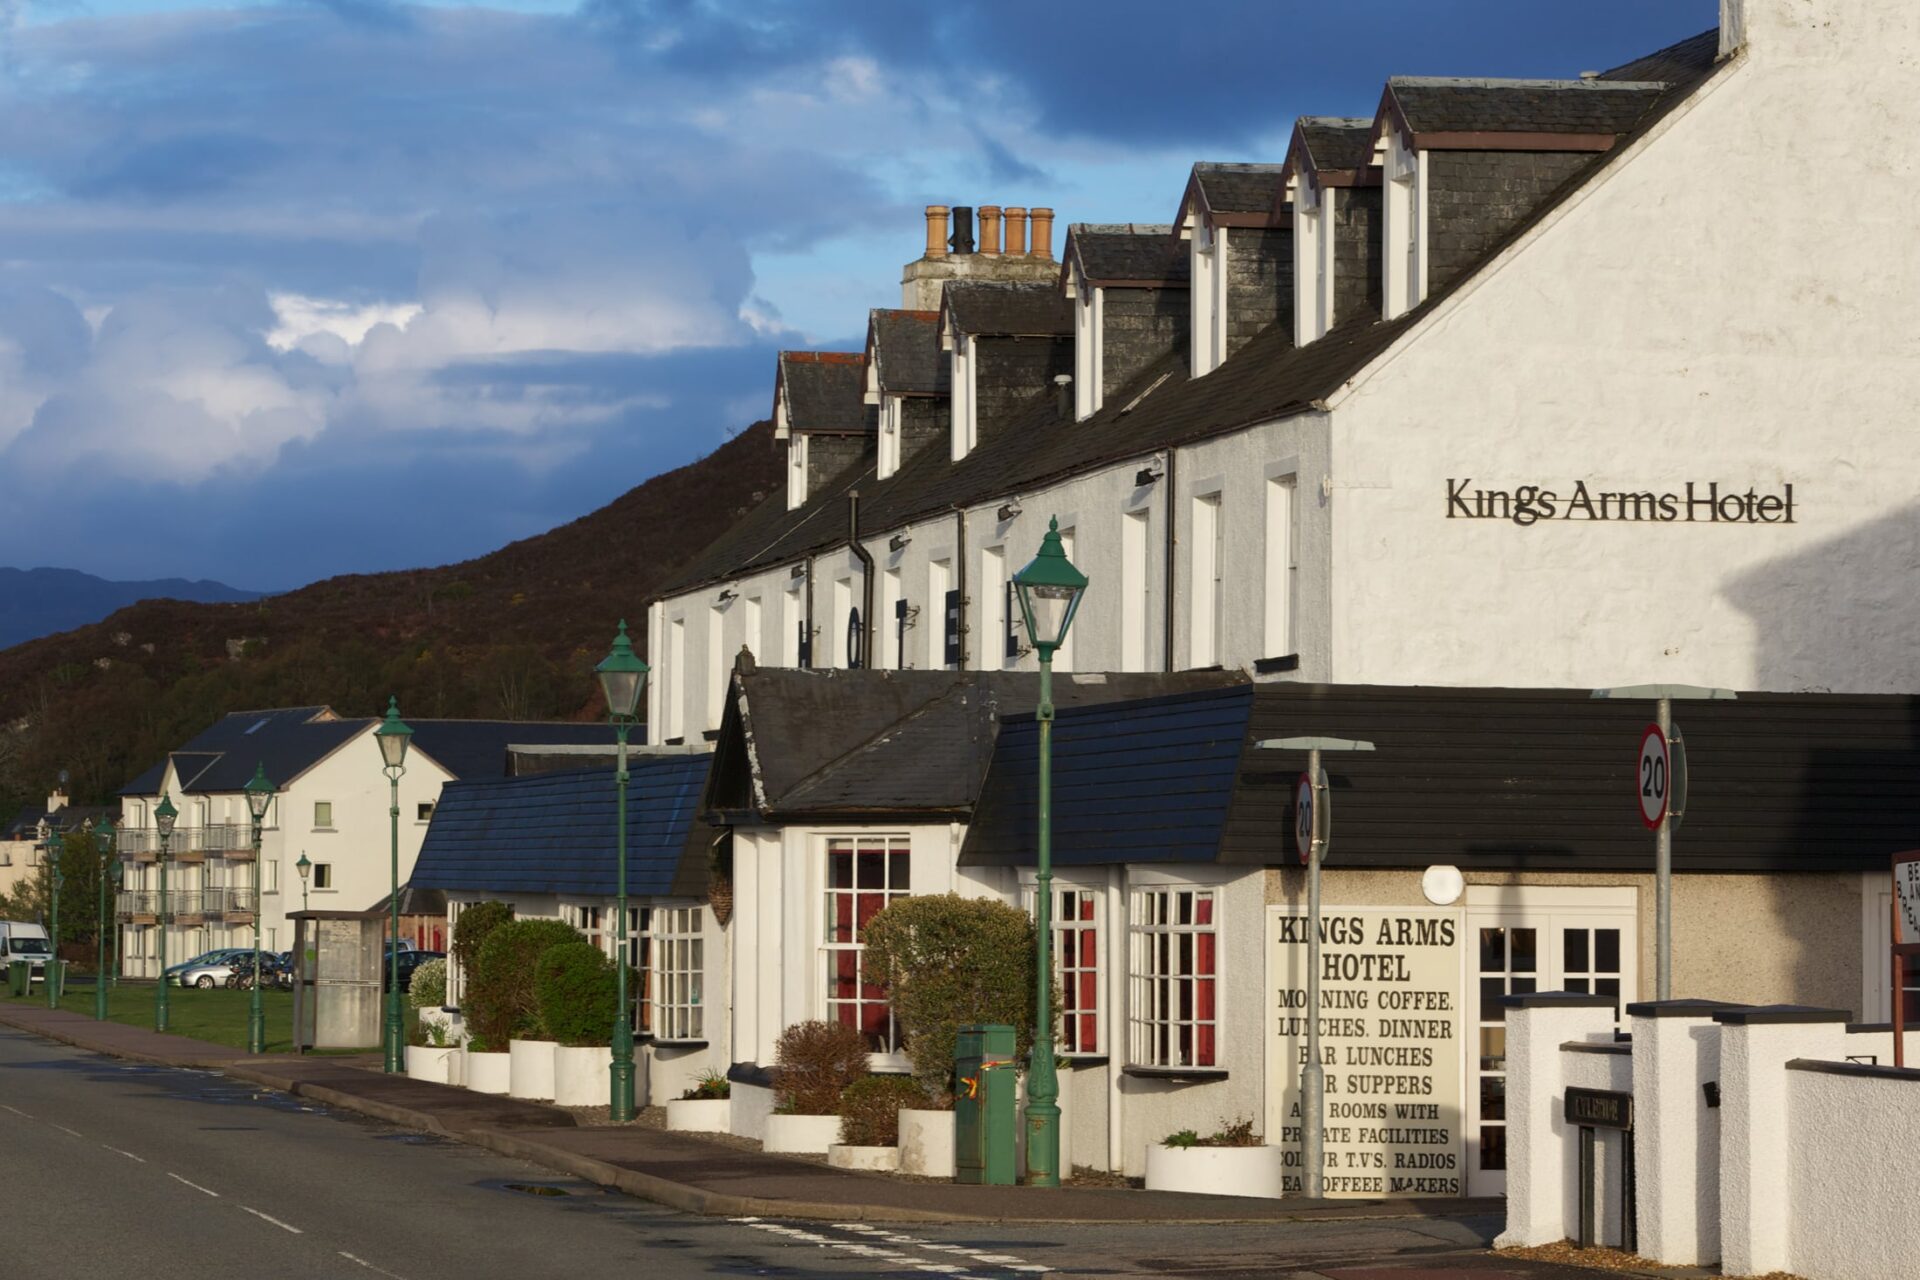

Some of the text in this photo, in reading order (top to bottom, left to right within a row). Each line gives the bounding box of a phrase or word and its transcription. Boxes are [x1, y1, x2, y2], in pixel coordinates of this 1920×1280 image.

[1446, 478, 1794, 526] Kings Arms Hotel
[1643, 755, 1665, 799] 20
[1376, 918, 1455, 946] ARMS
[1322, 953, 1410, 982] HOTEL
[1278, 989, 1453, 1011] MONING COFFEE.
[1379, 1019, 1452, 1039] DINNER
[1299, 1046, 1432, 1067] BR LUNCHES
[1347, 1074, 1432, 1095] SUPPERS
[1329, 1103, 1439, 1120] ROOMS WITH
[1281, 1127, 1449, 1145] PRATE FACILITIES
[1394, 1153, 1456, 1170] RADIOS
[1322, 1176, 1383, 1193] OFFEEE
[1390, 1177, 1459, 1194] MAKERS
